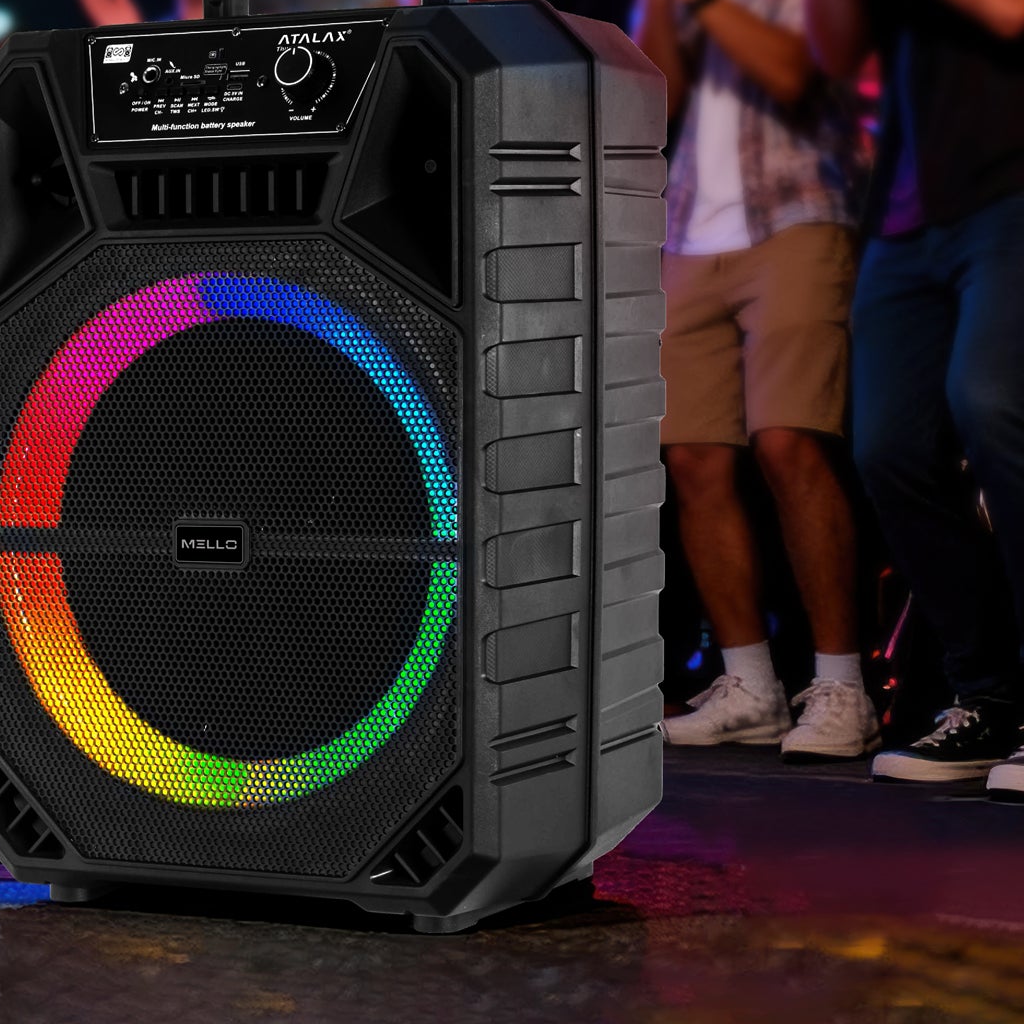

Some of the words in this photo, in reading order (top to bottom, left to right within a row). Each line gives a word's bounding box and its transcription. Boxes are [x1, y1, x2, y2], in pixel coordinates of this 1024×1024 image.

[151, 123, 199, 131] Multi-function
[200, 122, 225, 130] battery
[226, 120, 256, 128] speaker
[181, 539, 237, 550] MELLO
